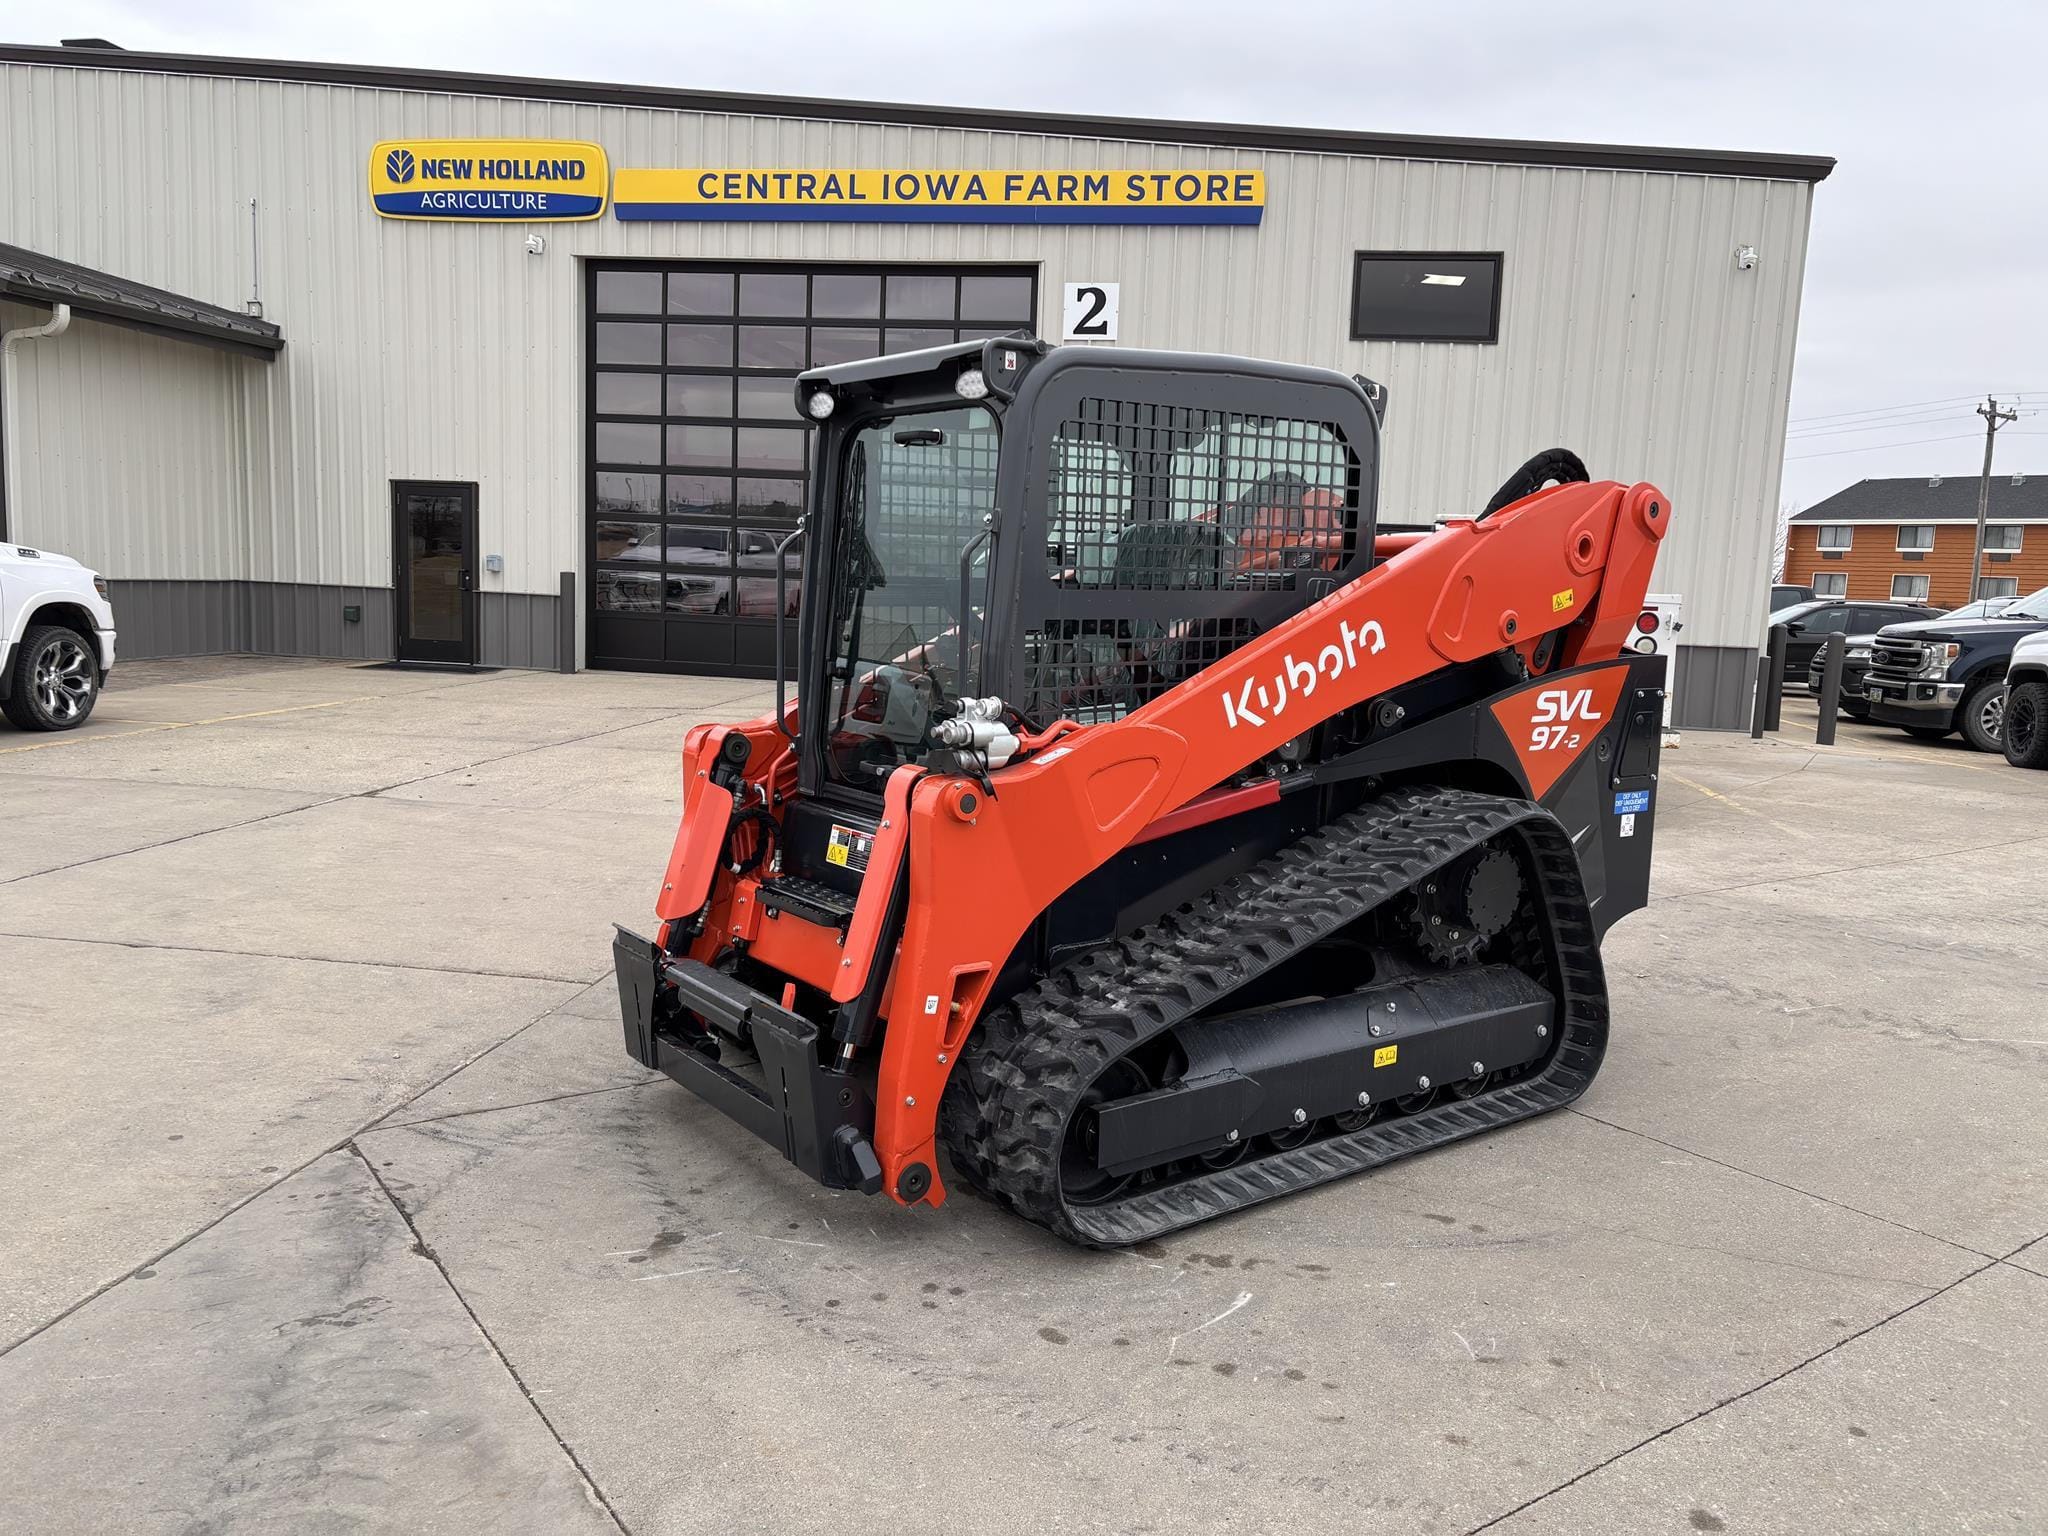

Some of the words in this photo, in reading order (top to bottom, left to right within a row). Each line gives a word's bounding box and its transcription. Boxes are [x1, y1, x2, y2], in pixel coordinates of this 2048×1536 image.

[421, 159, 473, 179] NEW
[479, 159, 586, 180] HOLLAND
[697, 172, 867, 200] CENTRAL
[882, 173, 988, 201] IOWA
[1004, 174, 1109, 201] FARM
[1126, 174, 1255, 201] STORE
[420, 193, 547, 210] AGRICULTURE
[1073, 287, 1108, 335] 2
[1222, 620, 1387, 729] Kubota
[1530, 689, 1602, 724] SVL
[1528, 725, 1581, 752] 97-2
